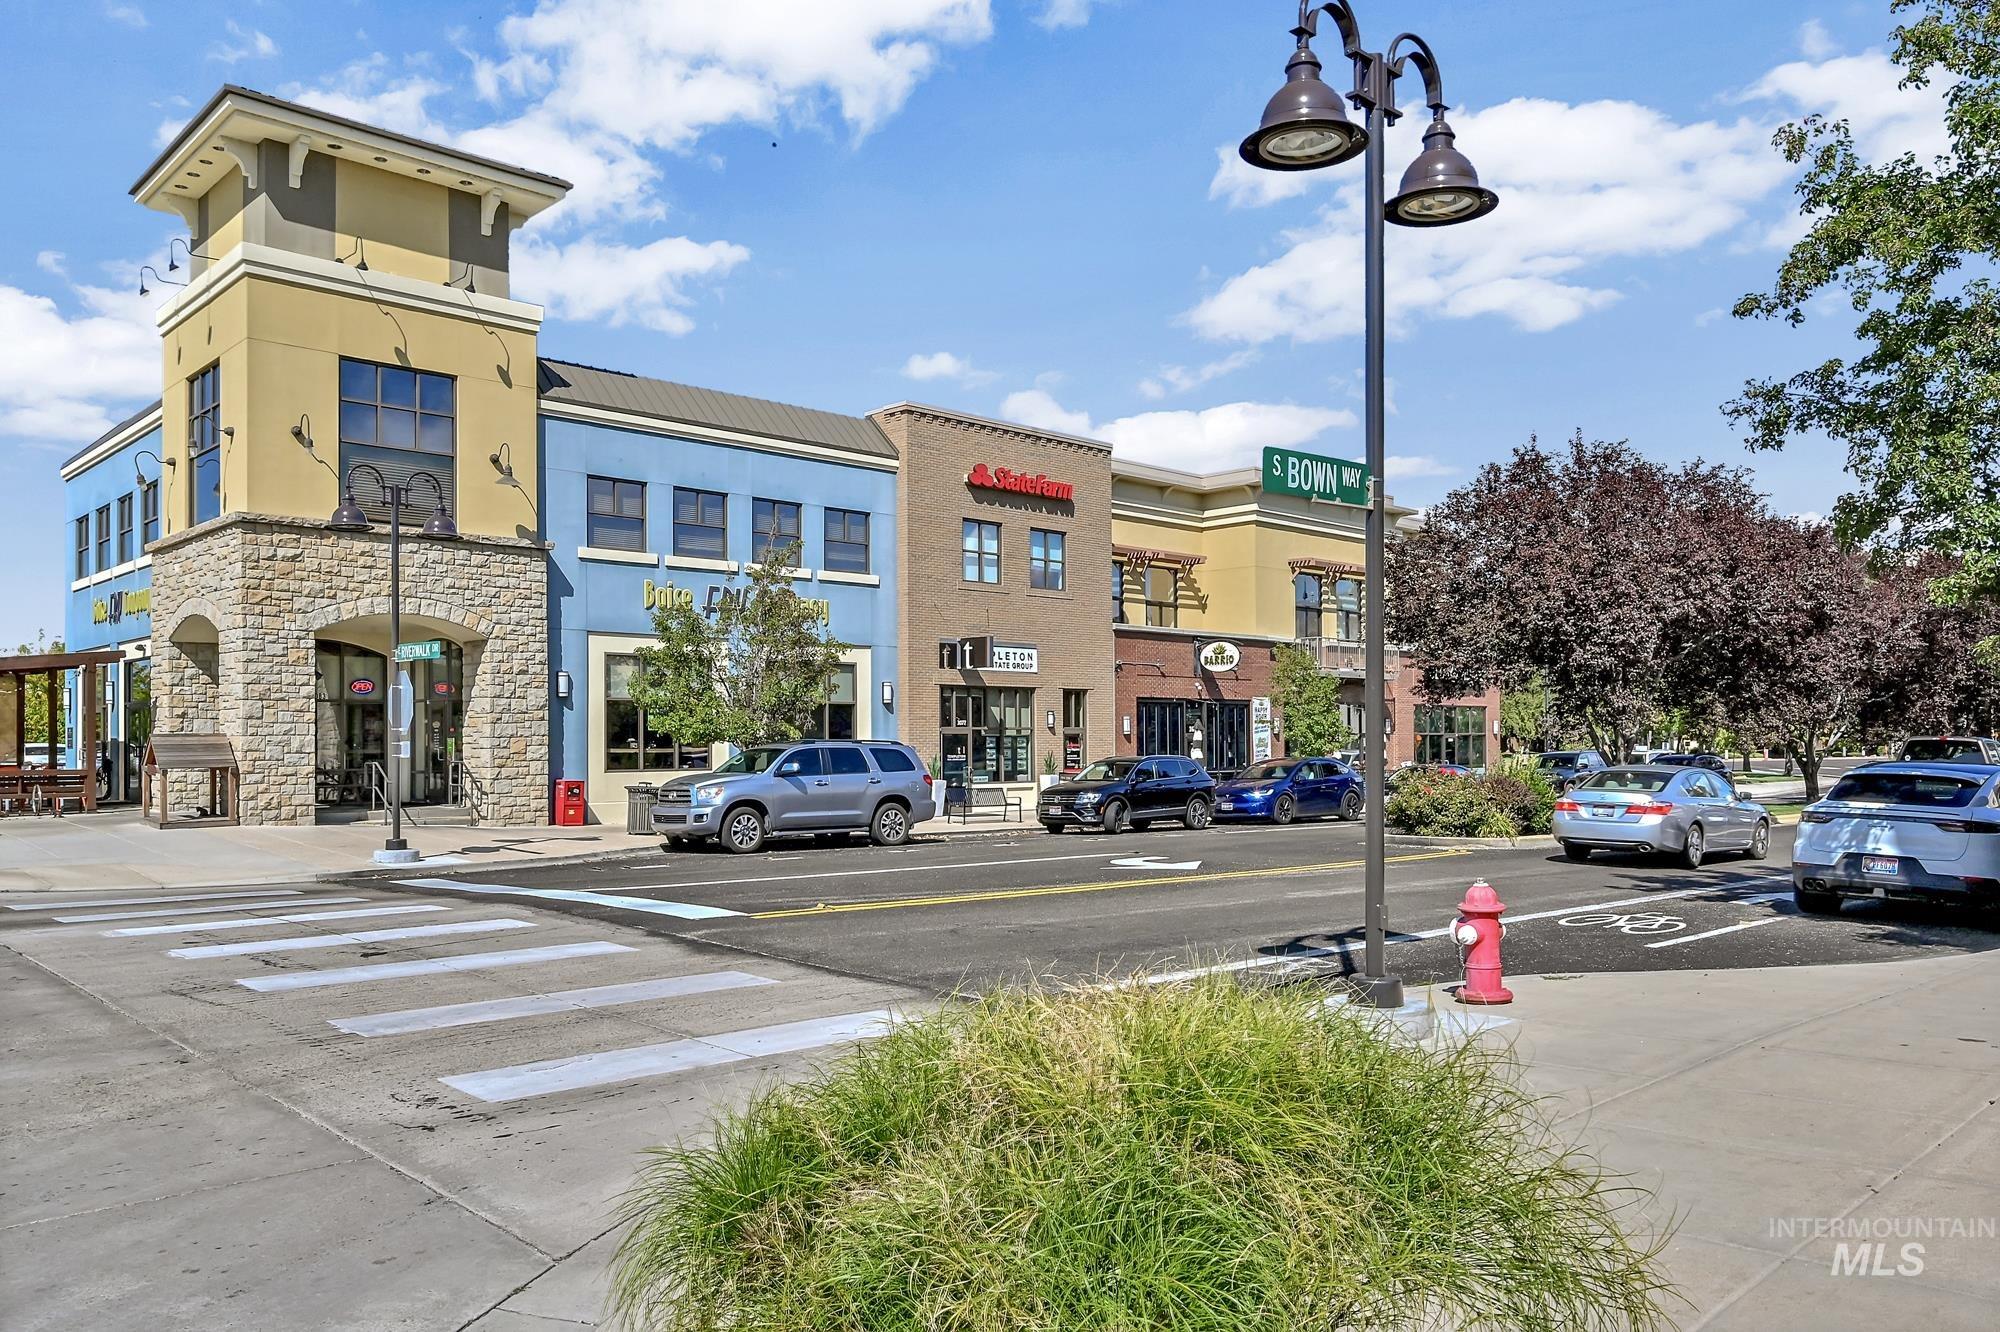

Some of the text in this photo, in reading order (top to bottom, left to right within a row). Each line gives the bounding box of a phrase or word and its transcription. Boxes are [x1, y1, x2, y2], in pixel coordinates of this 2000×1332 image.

[1272, 454, 1362, 495] S. BOWN WAY
[401, 644, 431, 658] RIVERWALK
[431, 643, 439, 652] DR
[993, 652, 1033, 661] LETON
[993, 661, 1033, 670] TATE GROUP
[1203, 654, 1235, 666] BARRIO
